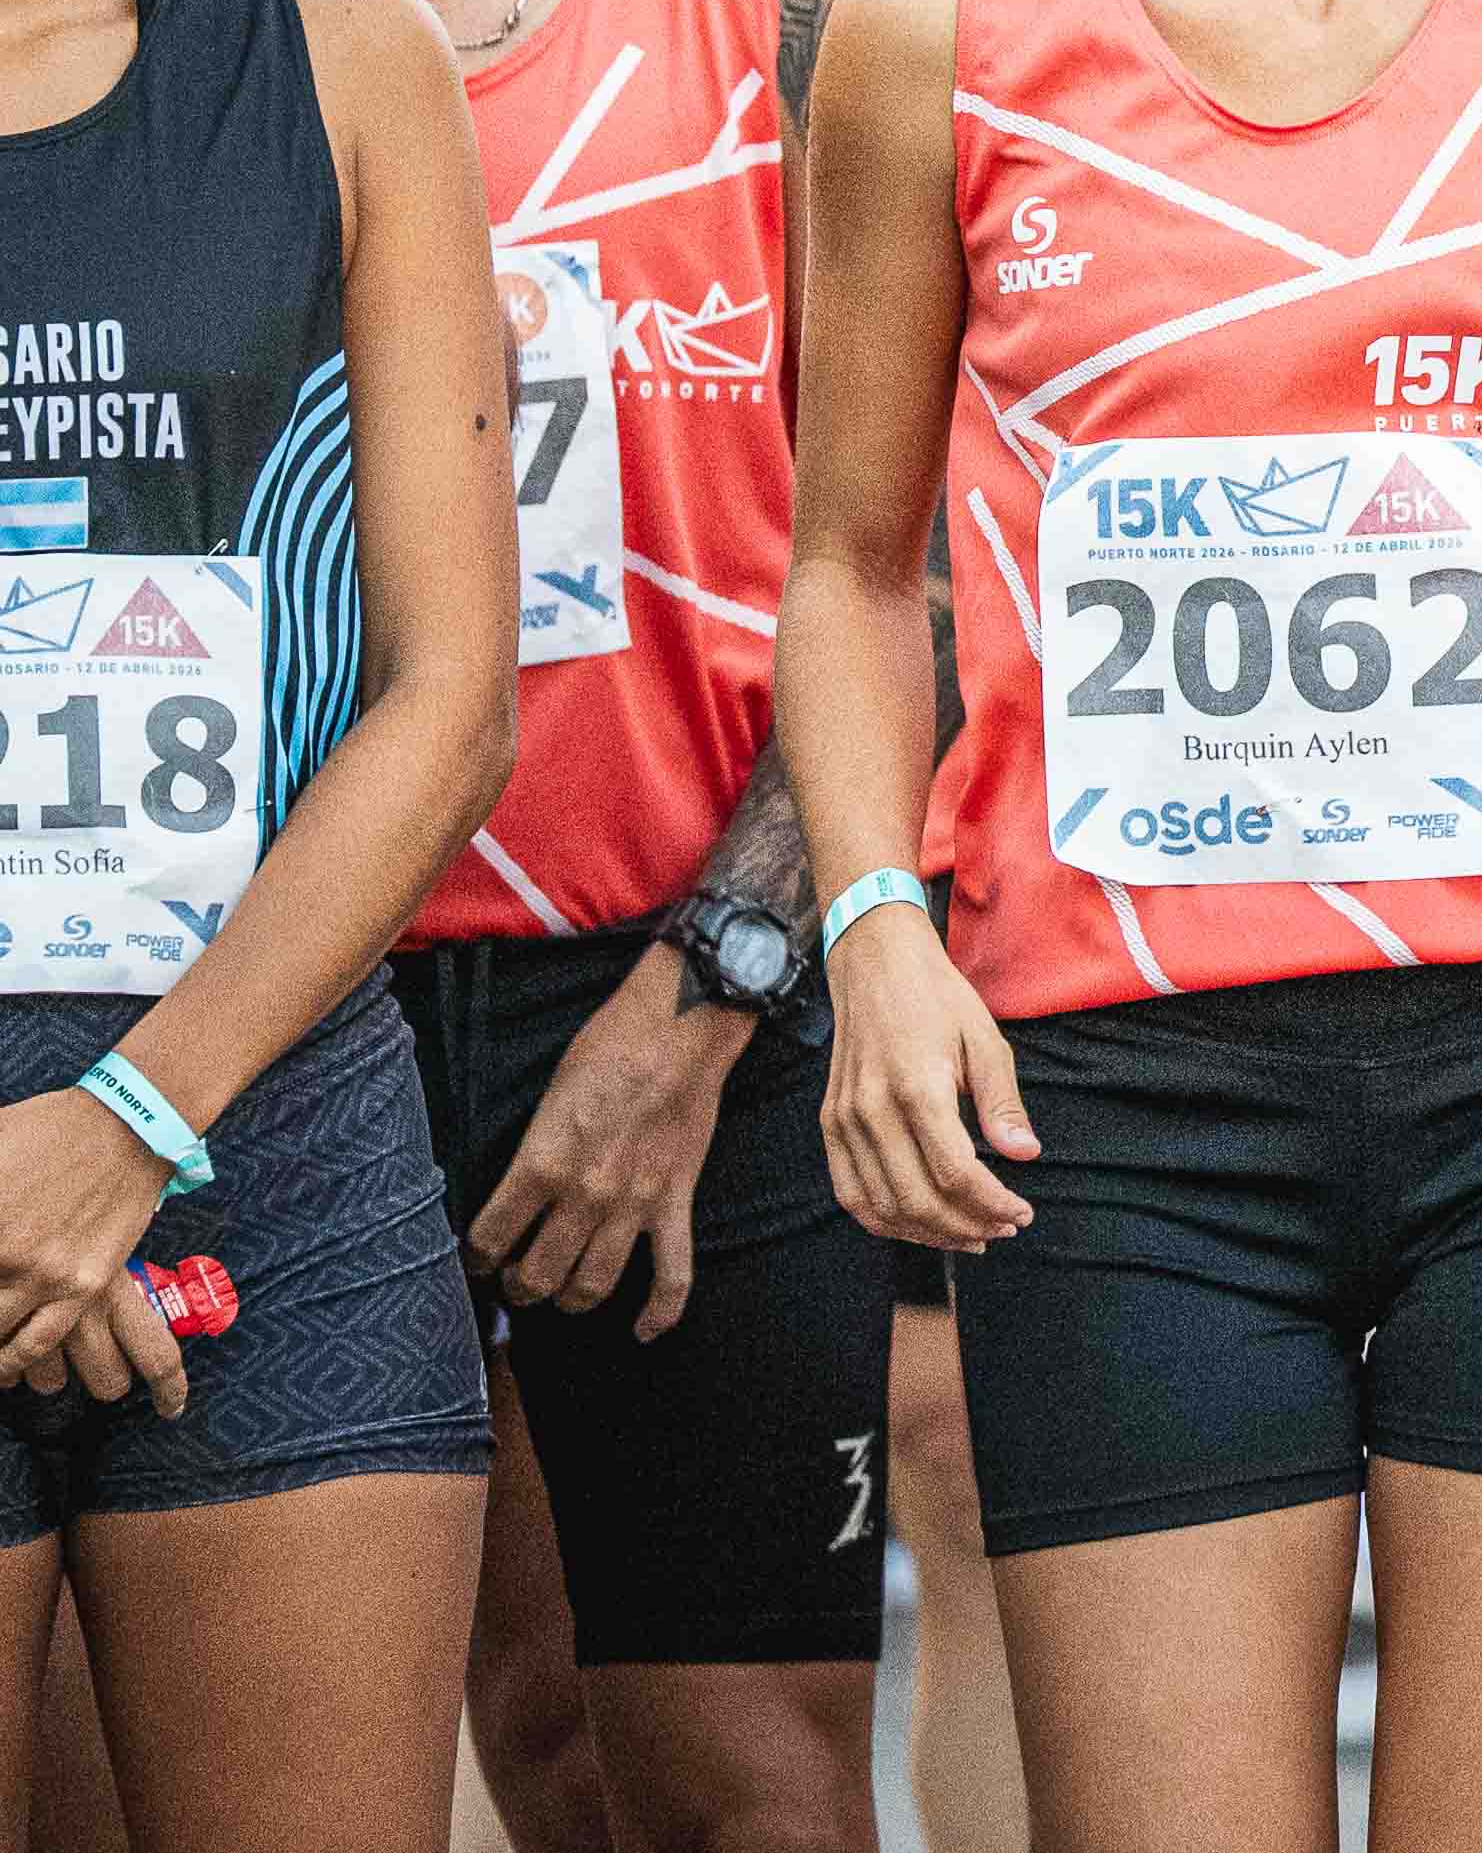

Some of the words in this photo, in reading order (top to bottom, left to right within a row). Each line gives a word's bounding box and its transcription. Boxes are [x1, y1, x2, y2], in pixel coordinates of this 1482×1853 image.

[0, 319, 125, 387] ARIO
[1087, 477, 1211, 539] 15K
[1375, 489, 1440, 526] 15K
[1088, 547, 1144, 560] PUERTO
[1150, 547, 1195, 559] NORTE
[1201, 547, 1235, 559] 2026
[1251, 544, 1316, 558] ROSARIO
[1333, 543, 1348, 555] 12
[1355, 542, 1374, 554] DE
[1379, 540, 1423, 553] ABRIL
[1429, 537, 1464, 549] 2026
[118, 615, 186, 647] 15K
[0, 662, 59, 676] OSARIO
[99, 662, 120, 675] DE
[168, 663, 202, 676] 2026
[0, 694, 238, 834] 18
[1183, 733, 1294, 766] Burquin
[1306, 731, 1389, 762] Aylen
[1119, 794, 1274, 848] osde
[1388, 813, 1459, 828] POWER
[54, 848, 126, 875] Sofía
[126, 934, 184, 948] POWER
[113, 1084, 157, 1125] NORTE
